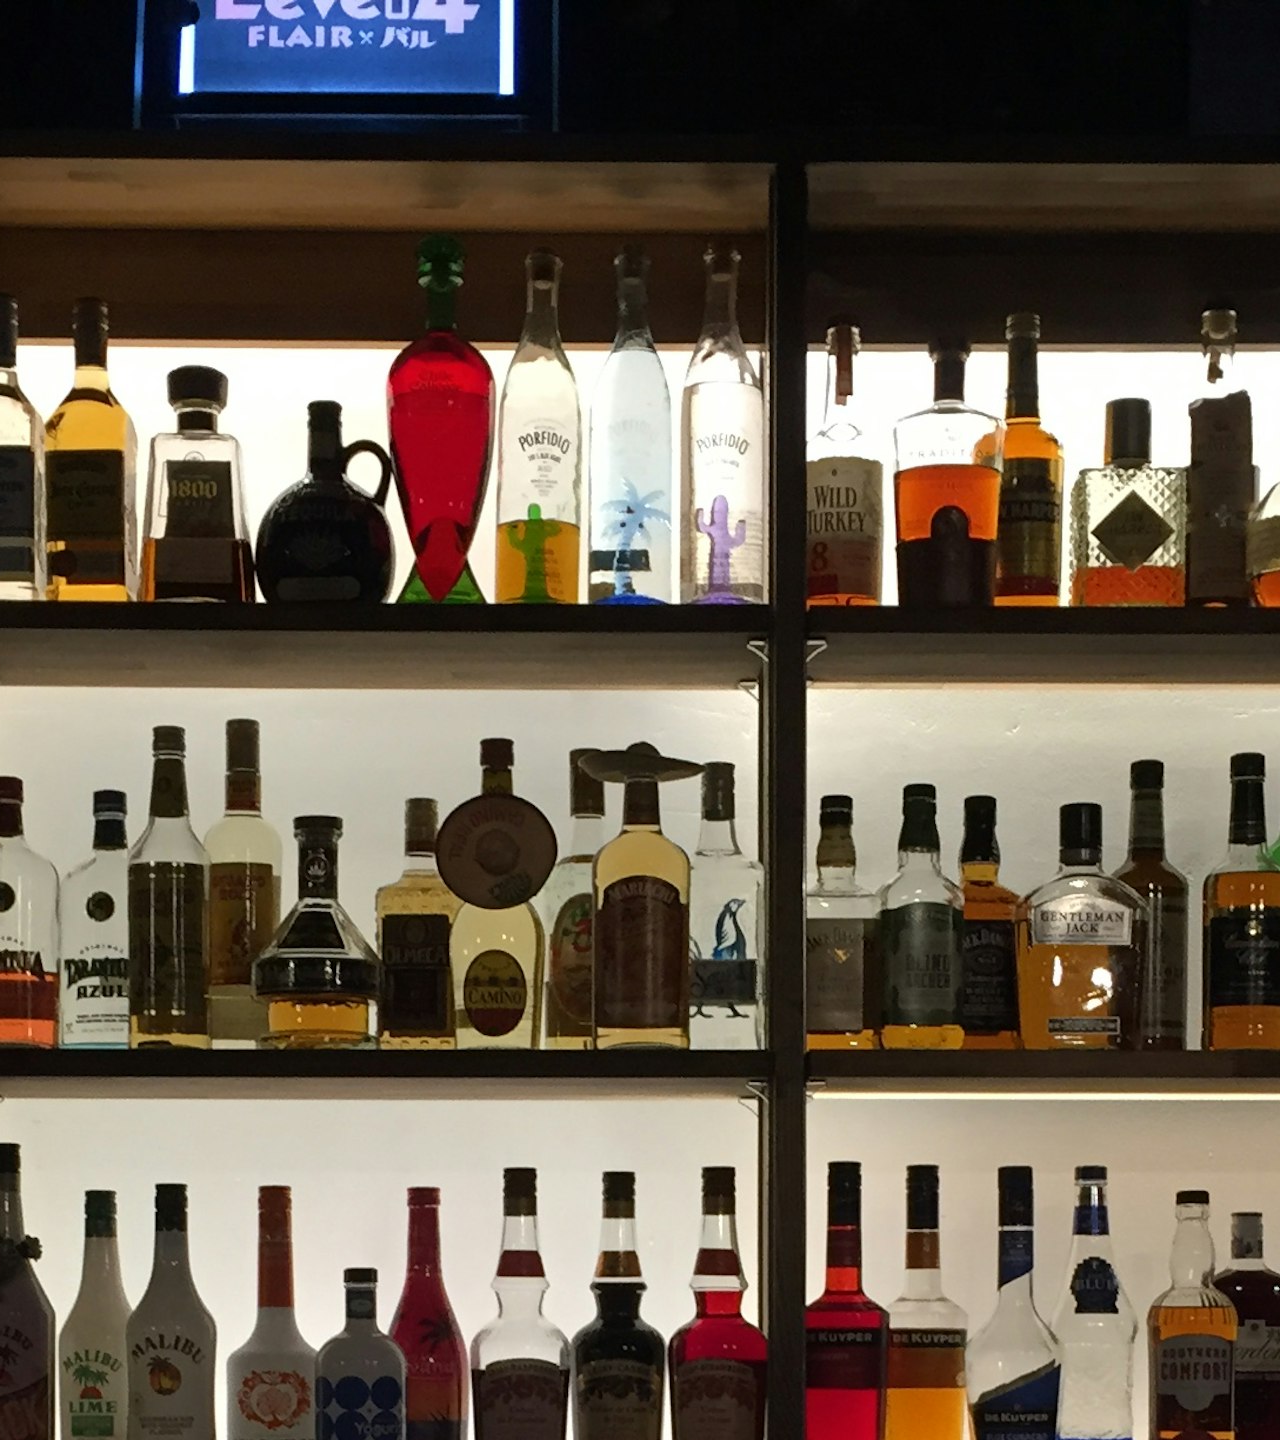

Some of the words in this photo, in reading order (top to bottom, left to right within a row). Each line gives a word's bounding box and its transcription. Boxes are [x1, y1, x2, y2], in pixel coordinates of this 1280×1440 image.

[248, 25, 354, 48] FLAIR
[380, 26, 438, 49] バル
[518, 430, 571, 455] PORFIDIO
[696, 433, 750, 456] PORFIDIO
[169, 479, 218, 498] 1800
[814, 485, 858, 508] WILD
[807, 509, 868, 534] TURKEY
[811, 540, 829, 573] 8
[1040, 911, 1125, 925] GENTLEMAN
[1066, 923, 1100, 939] JACK
[386, 945, 448, 966] OLMECA
[76, 984, 129, 999] AZUL
[468, 990, 523, 1006] CAMINO
[818, 1332, 873, 1343] KUYPER
[892, 1333, 909, 1344] DE
[910, 1332, 962, 1345] KUYPER
[131, 1332, 206, 1366] MALIBU
[1162, 1347, 1228, 1358] SOUTHERN
[62, 1349, 124, 1372] MALIBU
[1160, 1361, 1228, 1381] COMFORT
[68, 1400, 118, 1414] LIME
[984, 1412, 1000, 1423] DE
[1000, 1412, 1049, 1423] KUYPER
